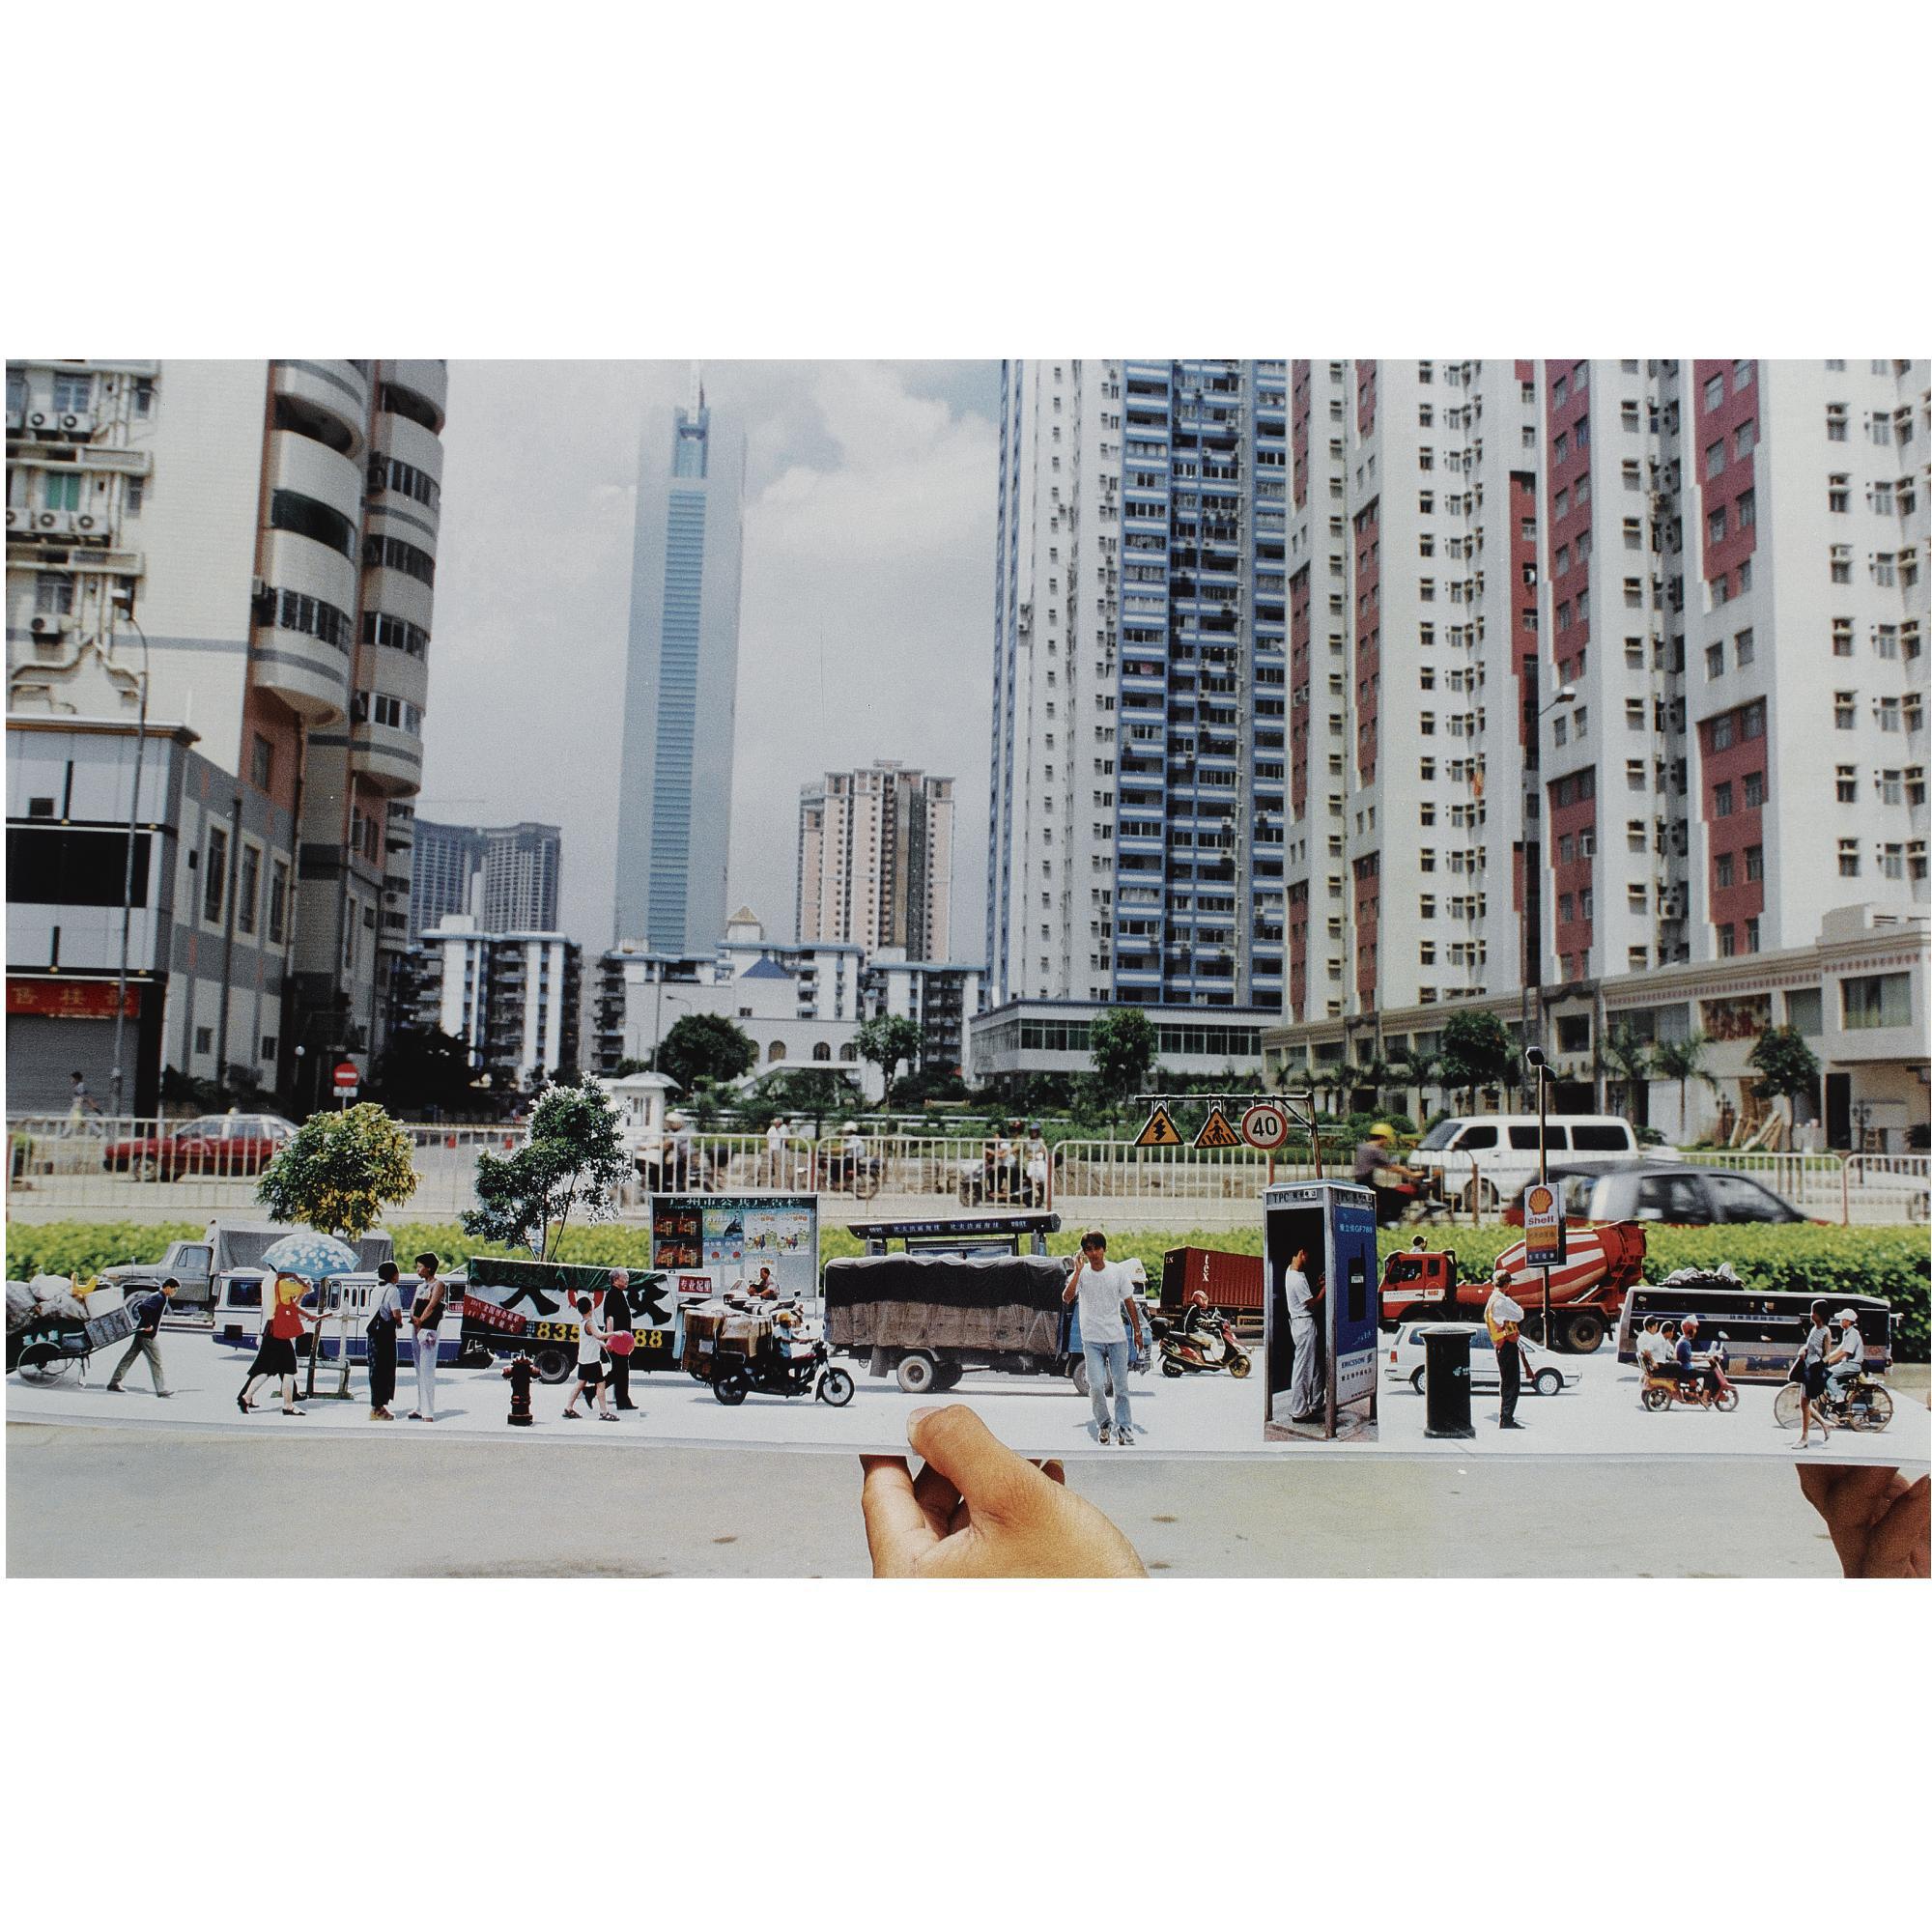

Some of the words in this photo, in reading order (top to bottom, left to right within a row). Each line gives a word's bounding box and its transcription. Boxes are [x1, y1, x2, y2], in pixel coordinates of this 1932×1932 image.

[1252, 1116, 1278, 1137] 40
[1273, 1192, 1290, 1204] TPC
[1528, 1214, 1554, 1226] Shell
[680, 1277, 712, 1293] 专业起重
